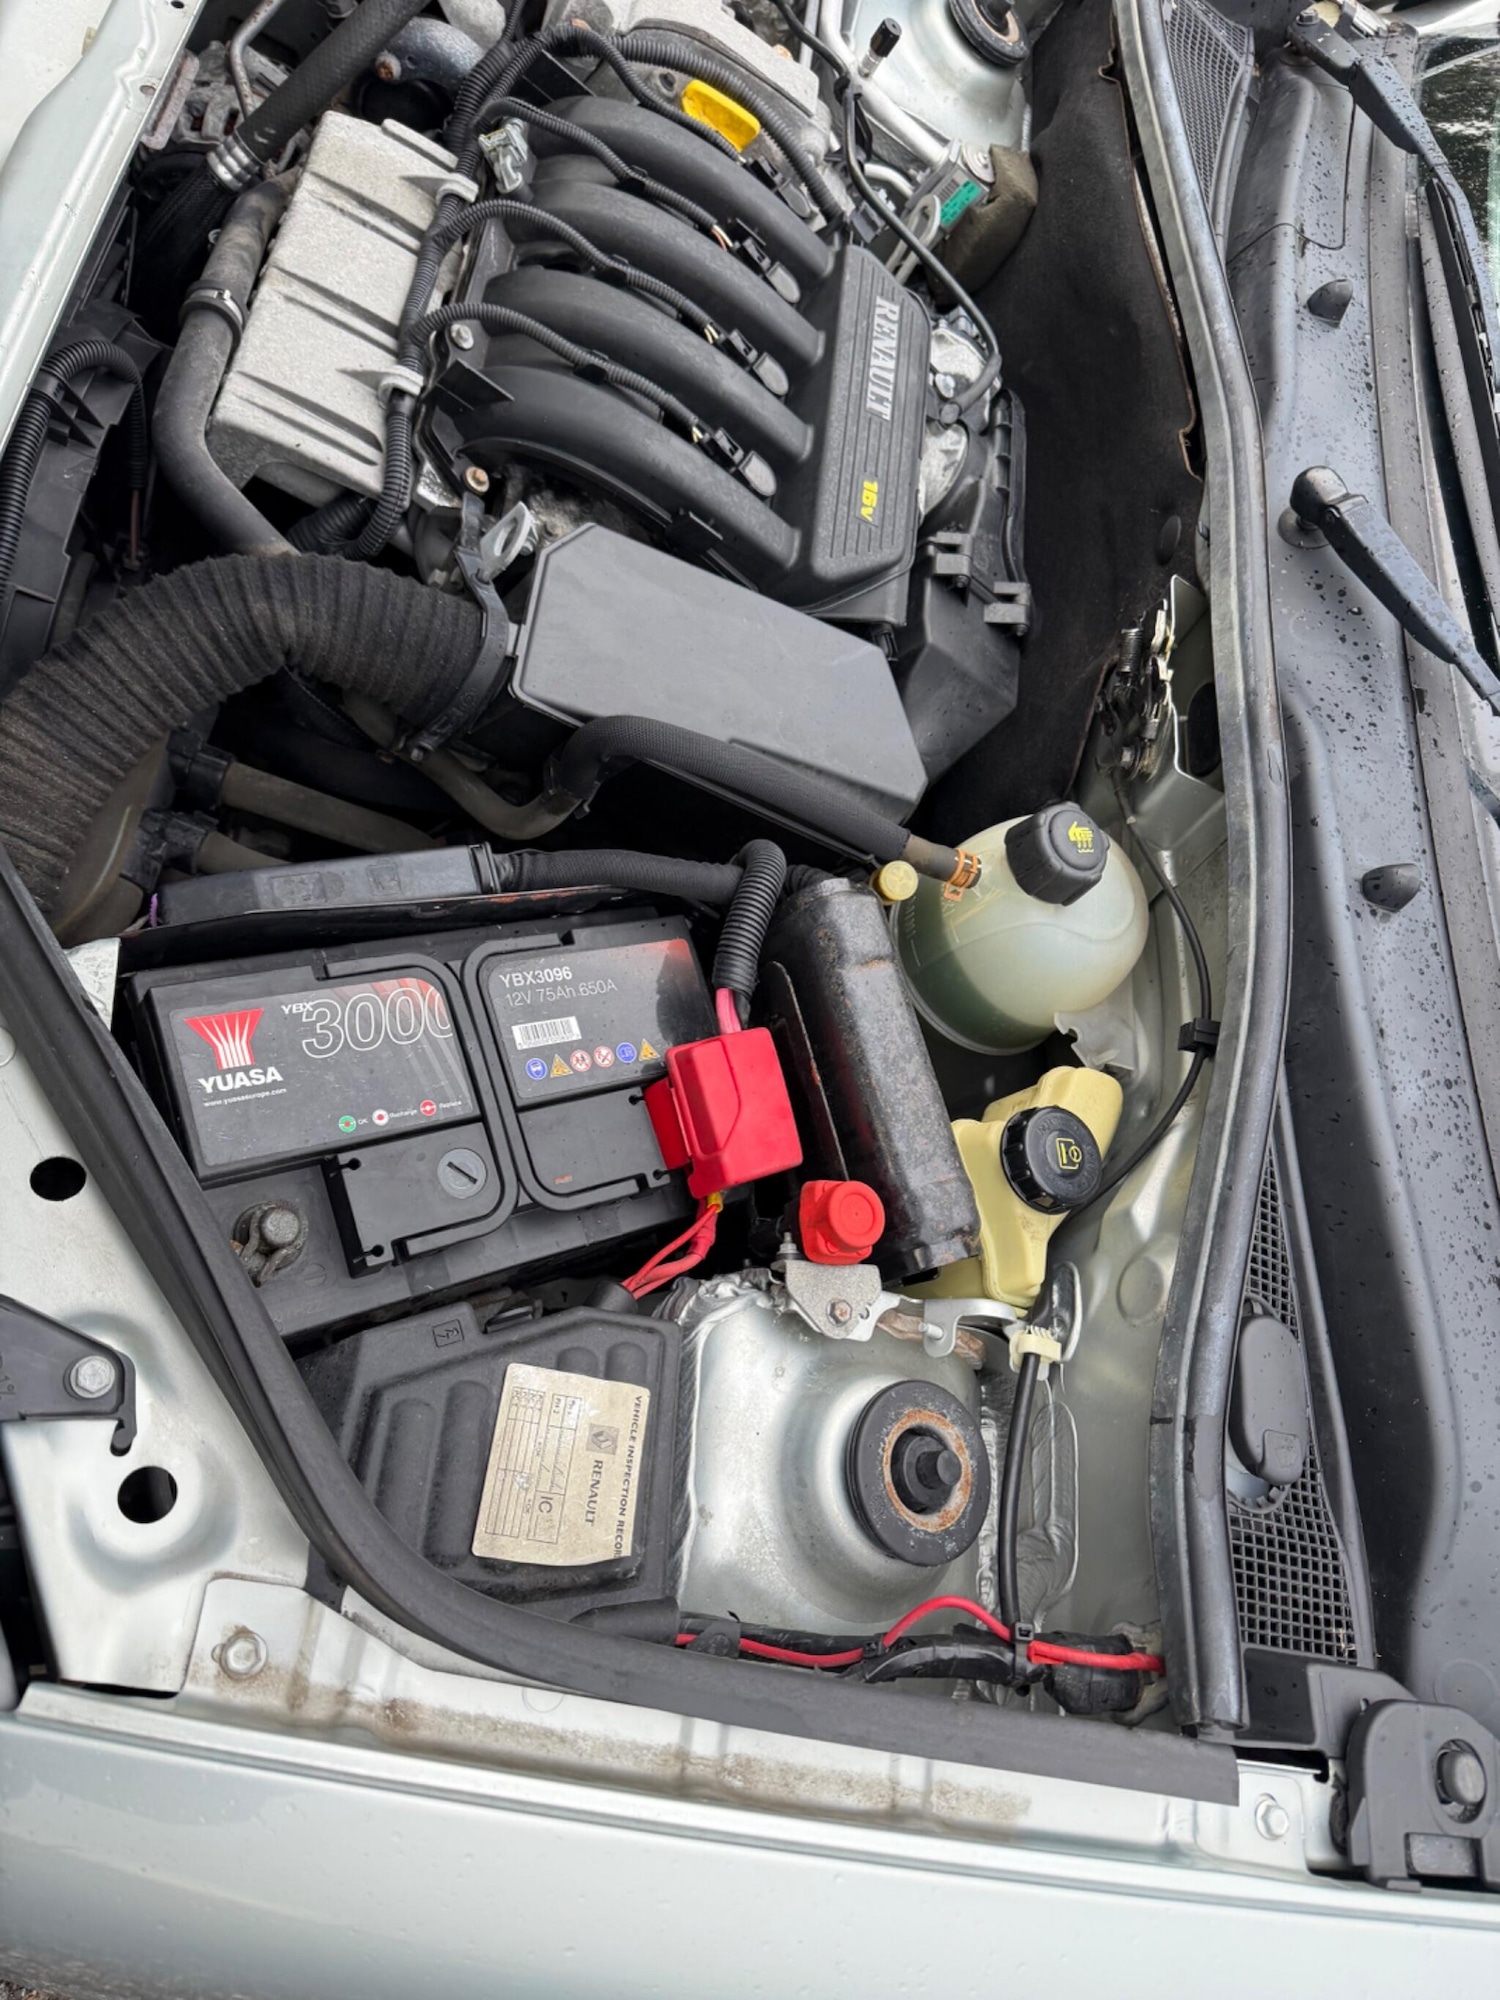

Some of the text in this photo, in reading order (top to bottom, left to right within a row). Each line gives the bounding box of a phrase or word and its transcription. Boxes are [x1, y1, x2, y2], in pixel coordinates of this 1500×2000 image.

[865, 296, 900, 422] RENAULT
[499, 966, 573, 988] YBX3096
[505, 978, 618, 1007] 12V 75Ah 650A
[281, 1001, 314, 1016] YBX
[198, 1066, 284, 1094] YUASA
[612, 1395, 643, 1559] VEHICLE INSPECTION RECOR
[538, 1496, 553, 1513] IC
[584, 1459, 603, 1526] RENAULT
